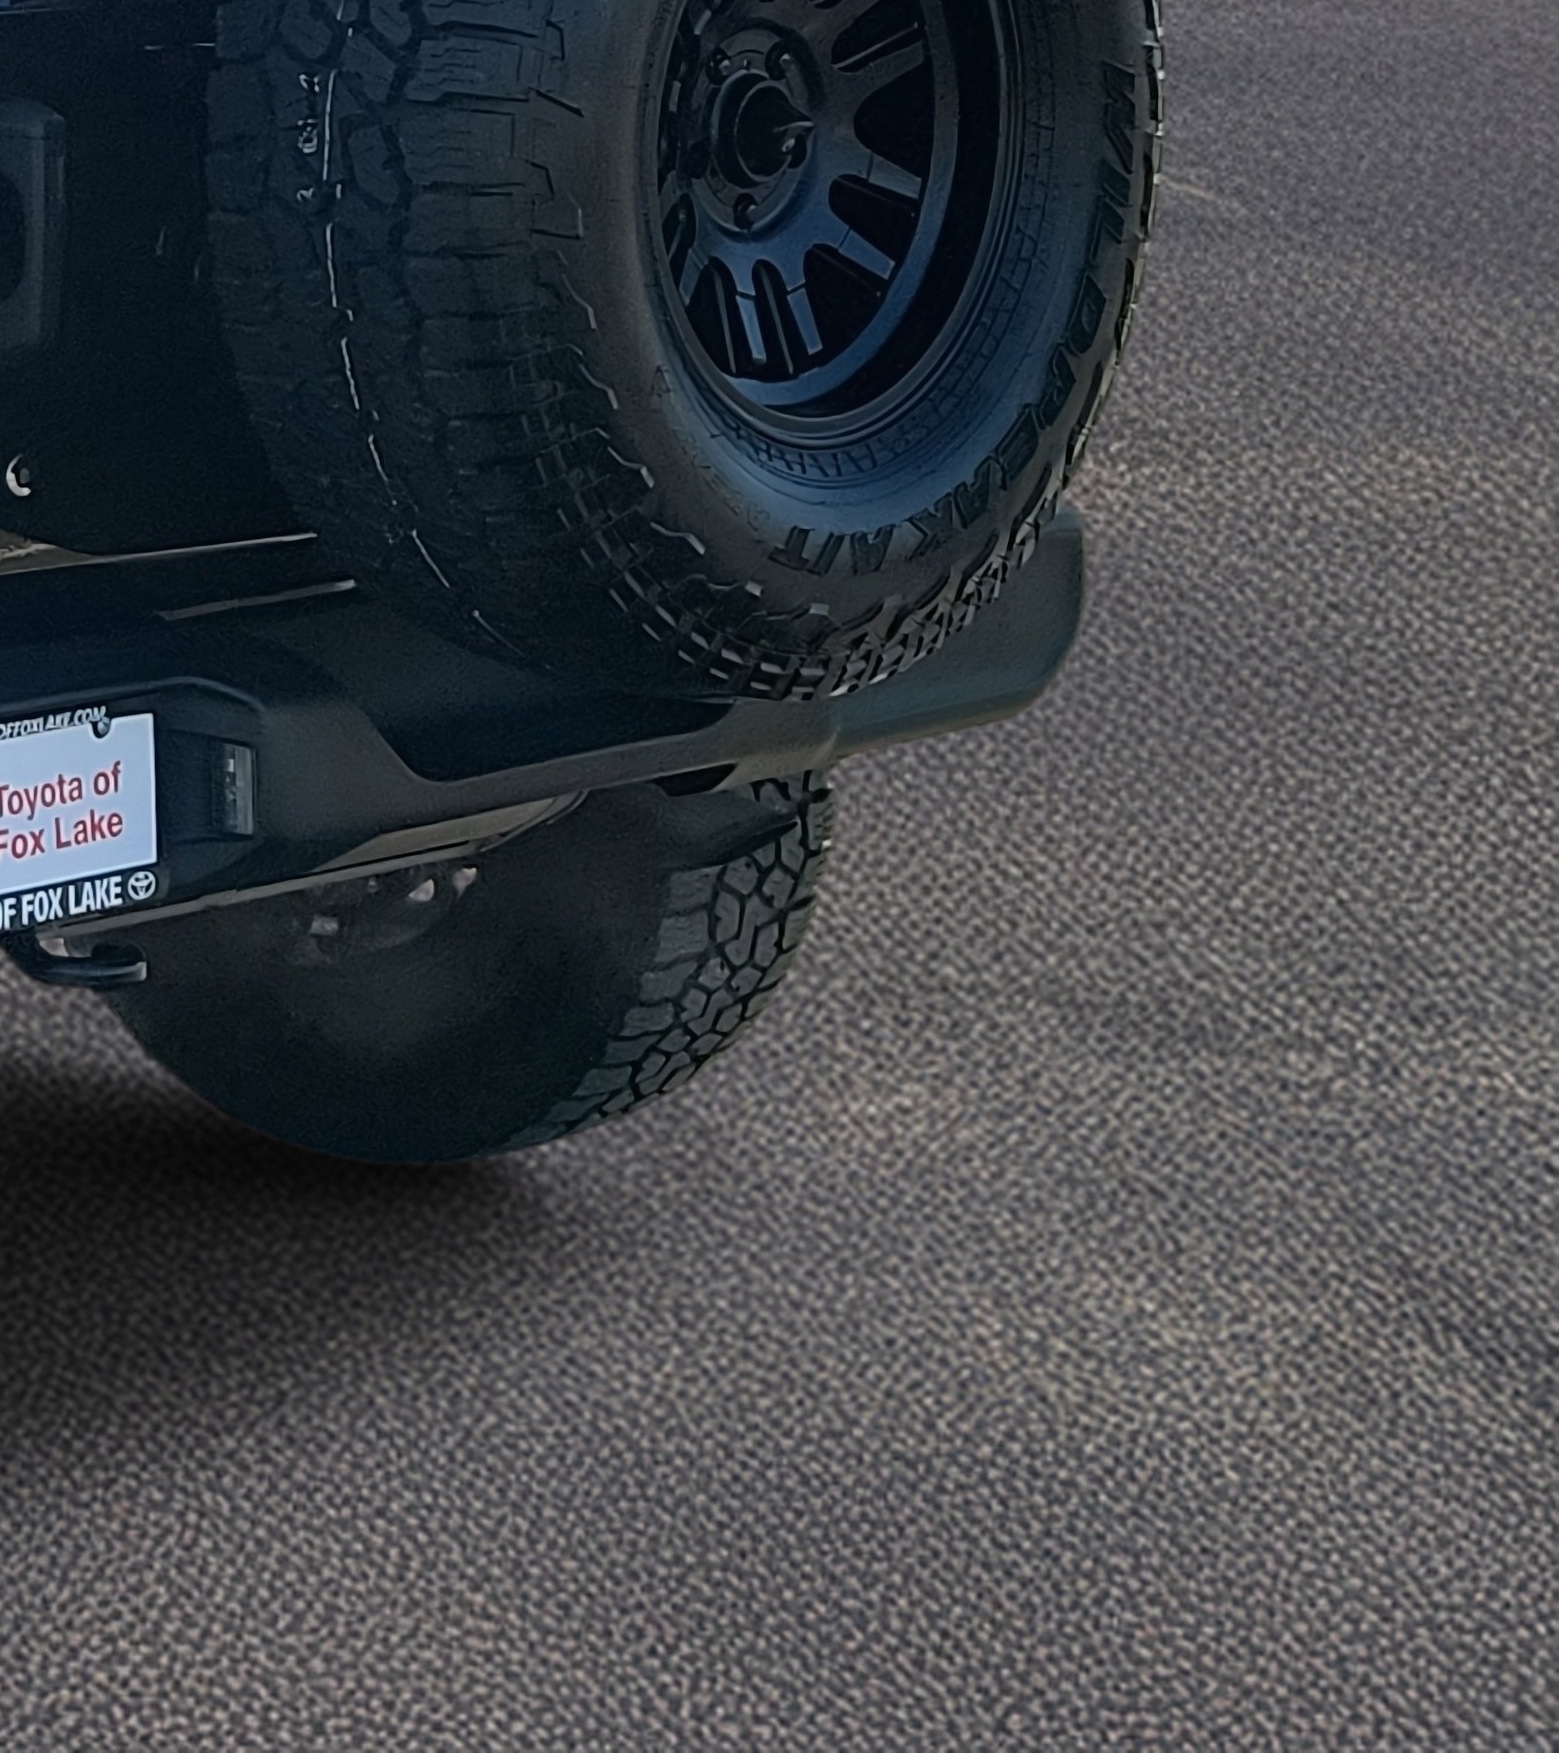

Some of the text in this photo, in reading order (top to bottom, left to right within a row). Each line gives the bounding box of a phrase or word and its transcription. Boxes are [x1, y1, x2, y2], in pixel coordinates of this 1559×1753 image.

[93, 760, 122, 796] of
[55, 809, 123, 849] Lake
[21, 889, 64, 926] FOX
[68, 877, 123, 913] LAKE
